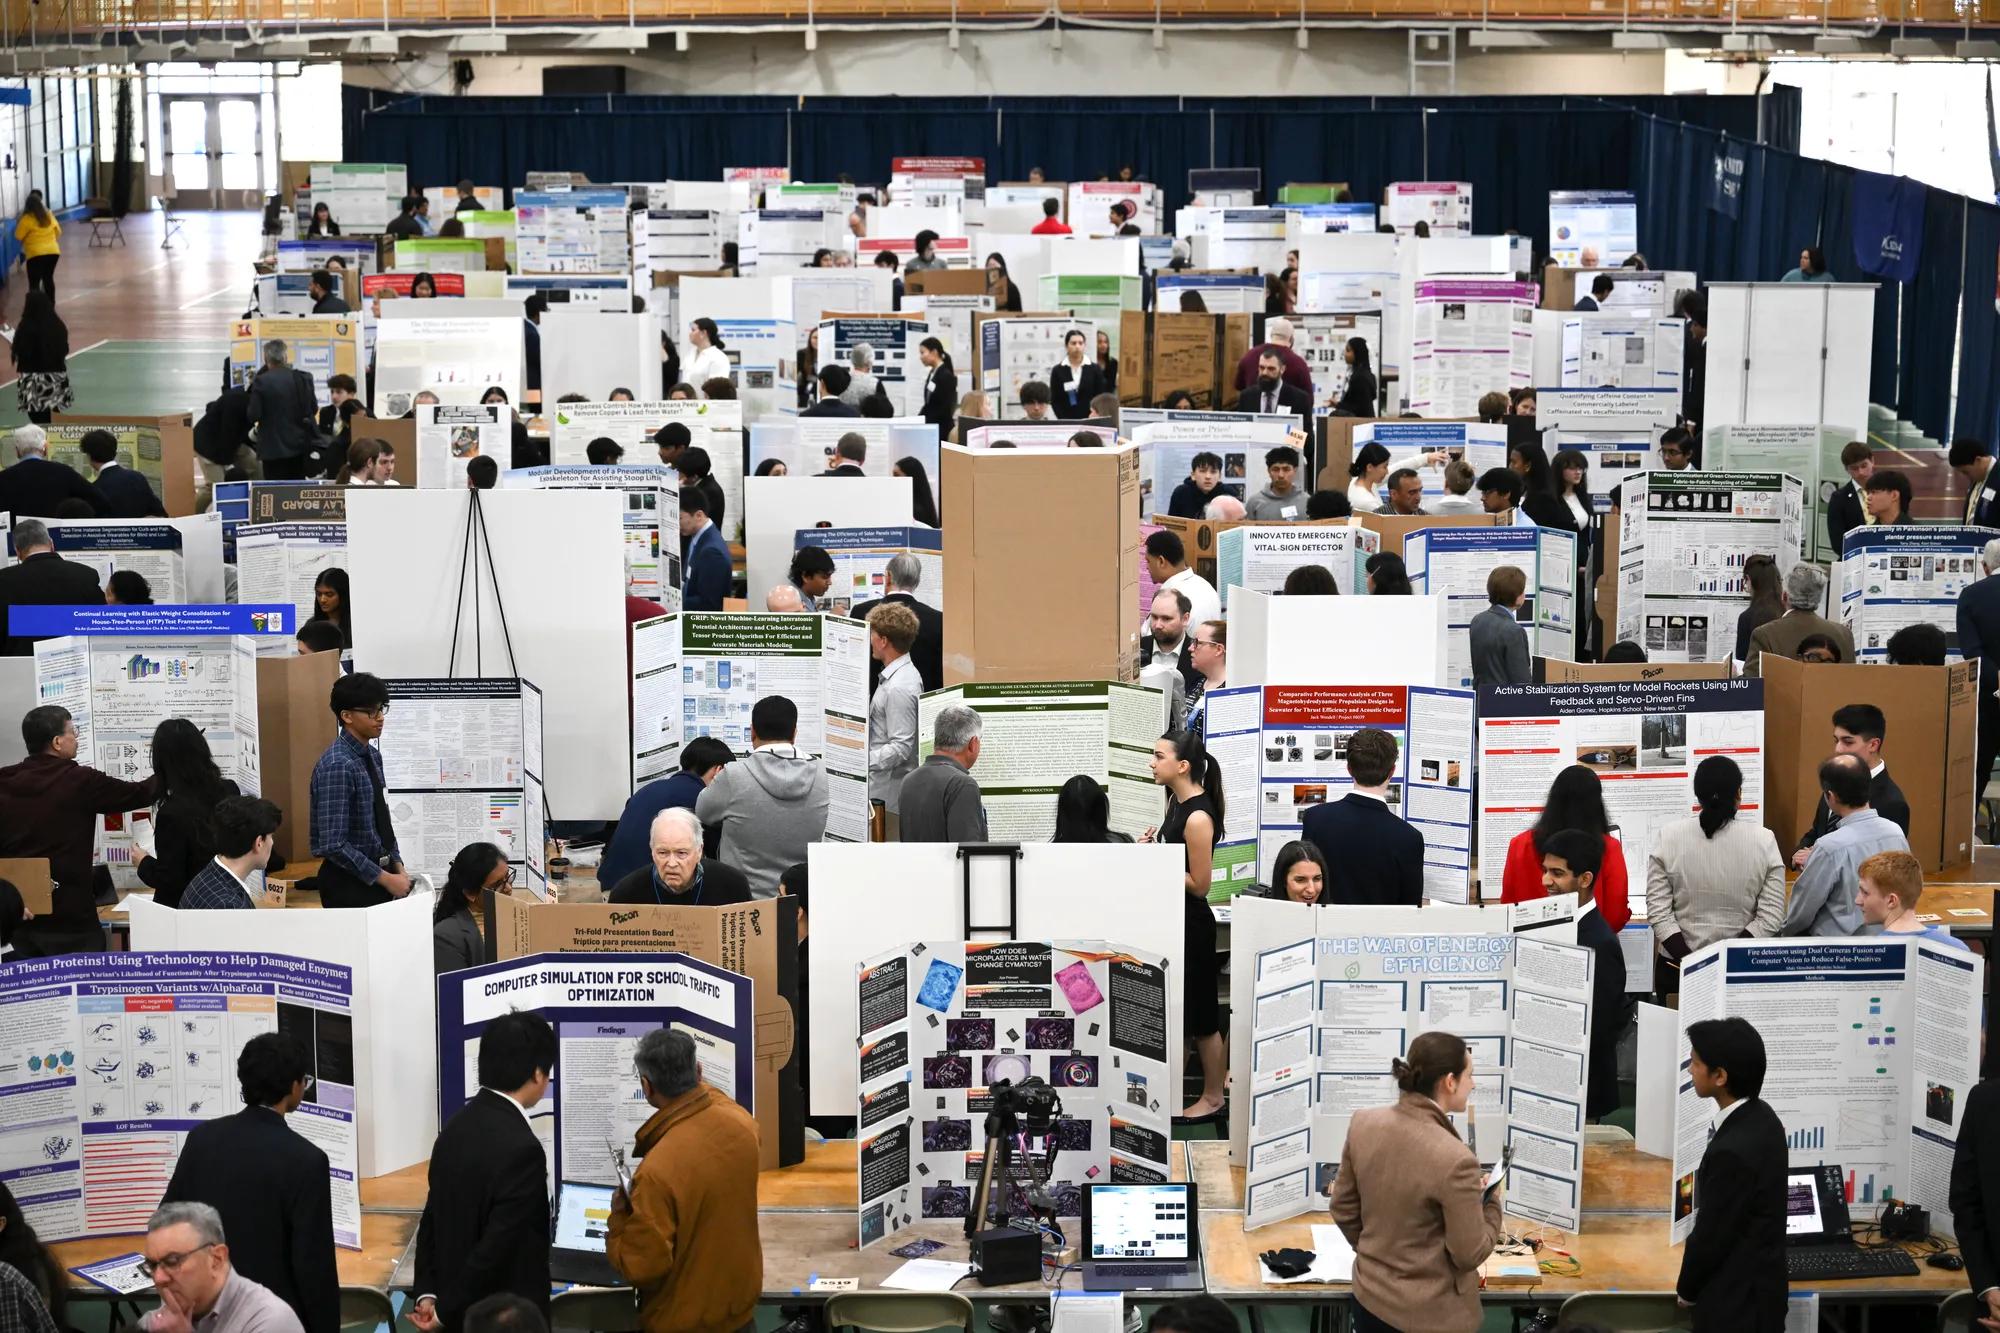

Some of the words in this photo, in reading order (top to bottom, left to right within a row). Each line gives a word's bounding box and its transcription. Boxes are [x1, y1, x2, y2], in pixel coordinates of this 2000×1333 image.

[282, 500, 319, 510] BOARD
[160, 610, 181, 618] Weight
[1641, 667, 1664, 680] Pacon
[1494, 685, 1523, 695] Active
[1525, 684, 1580, 695] Stabilization
[1582, 683, 1616, 694] System
[1618, 683, 1631, 692] for
[1633, 682, 1661, 692] Model
[1663, 681, 1700, 691] Rockets
[1702, 681, 1728, 692] Using
[1730, 680, 1749, 689] IMU
[1550, 696, 1594, 706] Feedback
[1597, 696, 1614, 705] and
[1616, 694, 1674, 705] Servo-Driven
[1676, 694, 1695, 703] Fins
[1599, 706, 1621, 714] Hopkins
[268, 883, 284, 894] 6027
[609, 910, 639, 926] Pacon
[749, 909, 761, 936] Pacon
[575, 927, 601, 935] Tri-Fold
[604, 928, 651, 936] Presentation
[652, 929, 674, 937] Board
[602, 939, 618, 947] para
[621, 939, 676, 947] presentaciones
[1319, 938, 1359, 955] THE
[1362, 937, 1407, 953] WAR
[1408, 937, 1438, 953] OF
[1438, 936, 1515, 953] ENERGY
[1761, 948, 1789, 956] detection
[1790, 947, 1807, 956] using
[17, 962, 50, 974] Them
[53, 956, 105, 969] Proteins!
[109, 955, 142, 967] Using
[145, 954, 212, 967] Technology
[216, 956, 227, 965] to
[231, 955, 258, 967] Help
[260, 955, 306, 972] Damaged
[309, 962, 348, 980] Enzymes
[1383, 955, 1506, 974] EFFICIENCY
[1751, 957, 1781, 966] Computer
[1783, 956, 1803, 964] Vision
[1804, 956, 1810, 964] to
[1835, 955, 1881, 963] False-Positives
[868, 961, 898, 981] ABSTRACT
[1121, 961, 1153, 978] PROCEDURE
[90, 984, 153, 995] Trypsinogen
[156, 983, 198, 992] Variants
[201, 983, 263, 994] w/AlphaFold
[485, 973, 538, 997] COMPUTER
[540, 971, 613, 984] SIMULATION
[618, 971, 643, 984] FOR
[647, 971, 688, 988] SCHOOL
[690, 976, 720, 999] TRAFFIC
[568, 988, 655, 1001] OPTIMIZATION
[598, 1026, 625, 1035] Findings
[694, 1033, 715, 1048] Conclusion
[872, 1039, 896, 1056] QUESTIONS
[872, 1086, 898, 1103] HYPOTHESIS
[870, 1129, 900, 1149] BACKGROUND
[1125, 1125, 1152, 1140] MATERIALS
[873, 1139, 896, 1155] RESEARCH
[19, 1166, 52, 1177] Hypothesis
[1114, 1167, 1134, 1180] FUTURE
[1118, 1161, 1149, 1177] CONCLUSION
[1150, 1171, 1161, 1181] AND
